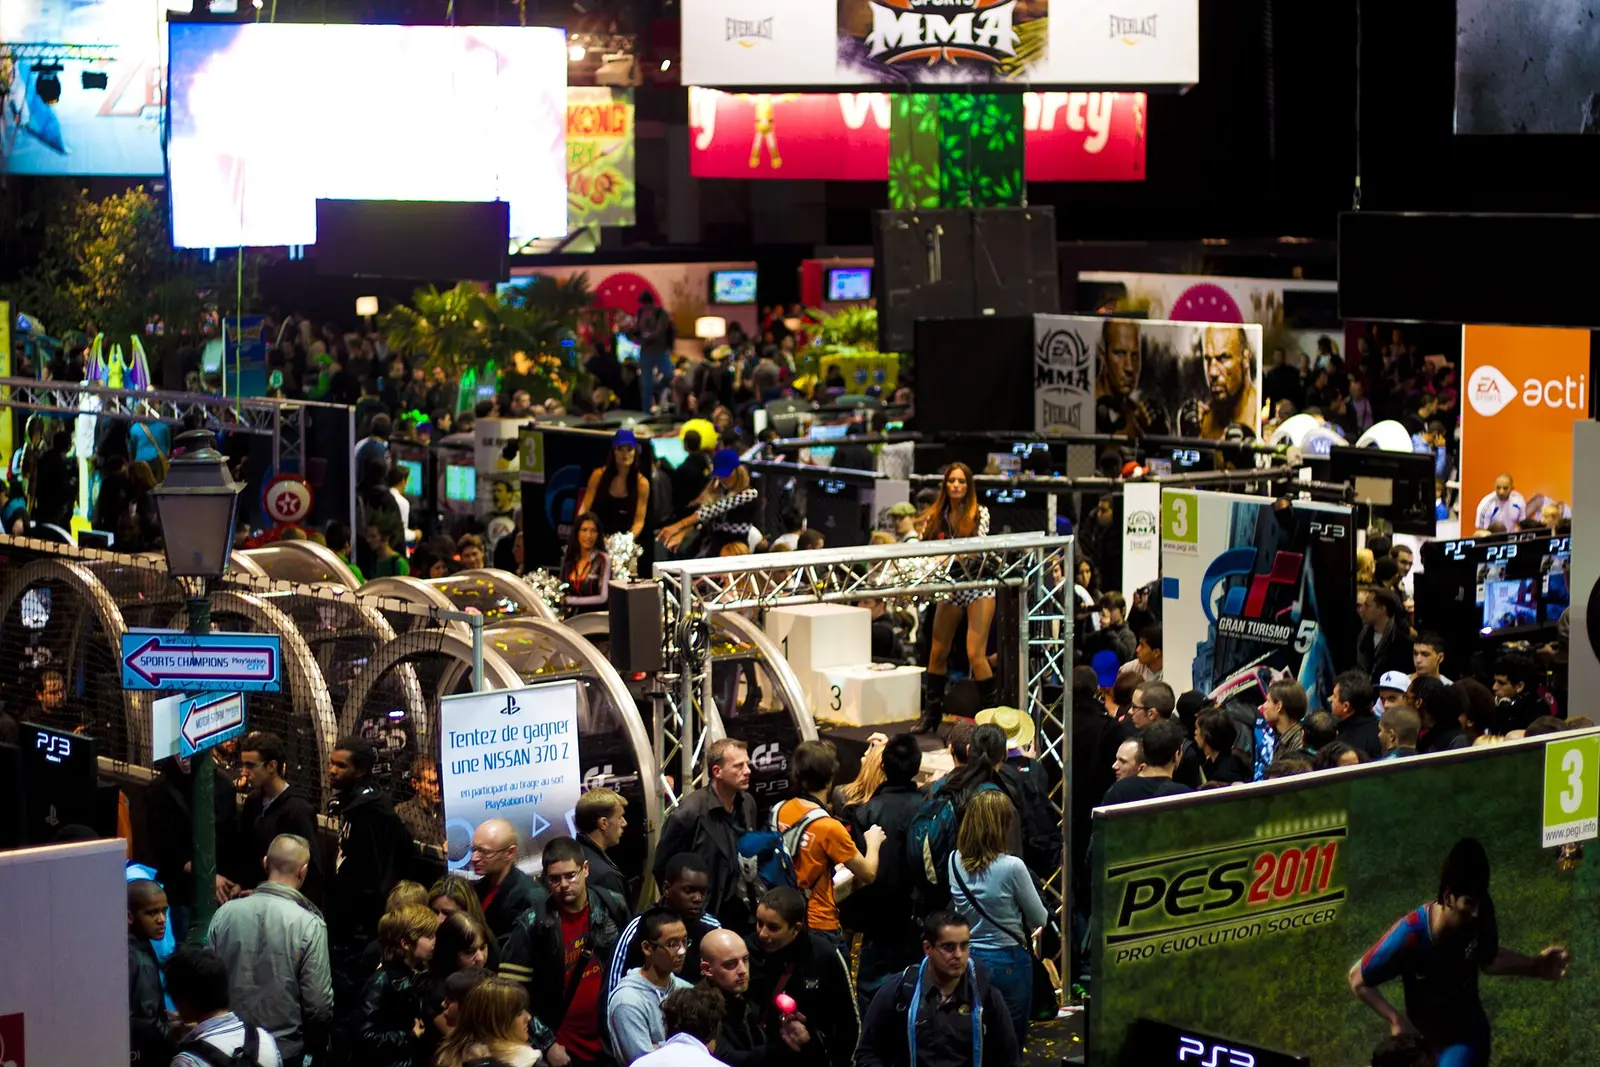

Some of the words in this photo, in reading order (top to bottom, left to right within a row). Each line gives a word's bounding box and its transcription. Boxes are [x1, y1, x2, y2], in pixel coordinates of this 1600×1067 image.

[725, 16, 774, 41] EVERLAST
[864, 0, 1021, 58] MMA
[1108, 13, 1158, 38] EVERLAST
[567, 103, 626, 134] KONG
[1036, 365, 1092, 394] MMA
[1476, 376, 1500, 392] EA
[1522, 374, 1585, 410] acti
[1043, 399, 1083, 429] EVERLAST
[1172, 498, 1188, 537] 3
[1310, 521, 1345, 538] PS3
[1487, 544, 1518, 561] PS3
[1218, 617, 1247, 634] GRAN
[1246, 620, 1291, 640] TURISMO
[1293, 619, 1316, 653] 5
[140, 656, 175, 668] SPORTS
[177, 656, 229, 668] CHAMPIONS
[830, 685, 842, 711] 3
[37, 732, 71, 756] PS3
[449, 728, 497, 748] Tentez
[502, 725, 518, 742] de
[523, 719, 569, 744] gagner
[452, 757, 479, 775] une
[484, 748, 531, 770] NISSAN
[535, 744, 558, 763] 370
[562, 742, 569, 760] Z
[460, 789, 471, 798] en
[471, 782, 508, 799] participant
[509, 783, 519, 791] au
[520, 777, 540, 790] tirage
[540, 776, 549, 785] au
[550, 775, 564, 784] sort
[756, 779, 789, 793] PS3
[1560, 749, 1584, 814] 3
[485, 796, 524, 810] PlayStation
[525, 795, 539, 805] City
[1545, 820, 1597, 842] www.pegi.info
[1117, 860, 1249, 928] PES
[1247, 840, 1337, 904] 2011
[1116, 947, 1155, 964] PRO
[1267, 908, 1336, 934] SOCCER
[1179, 1036, 1255, 1067] PS3
